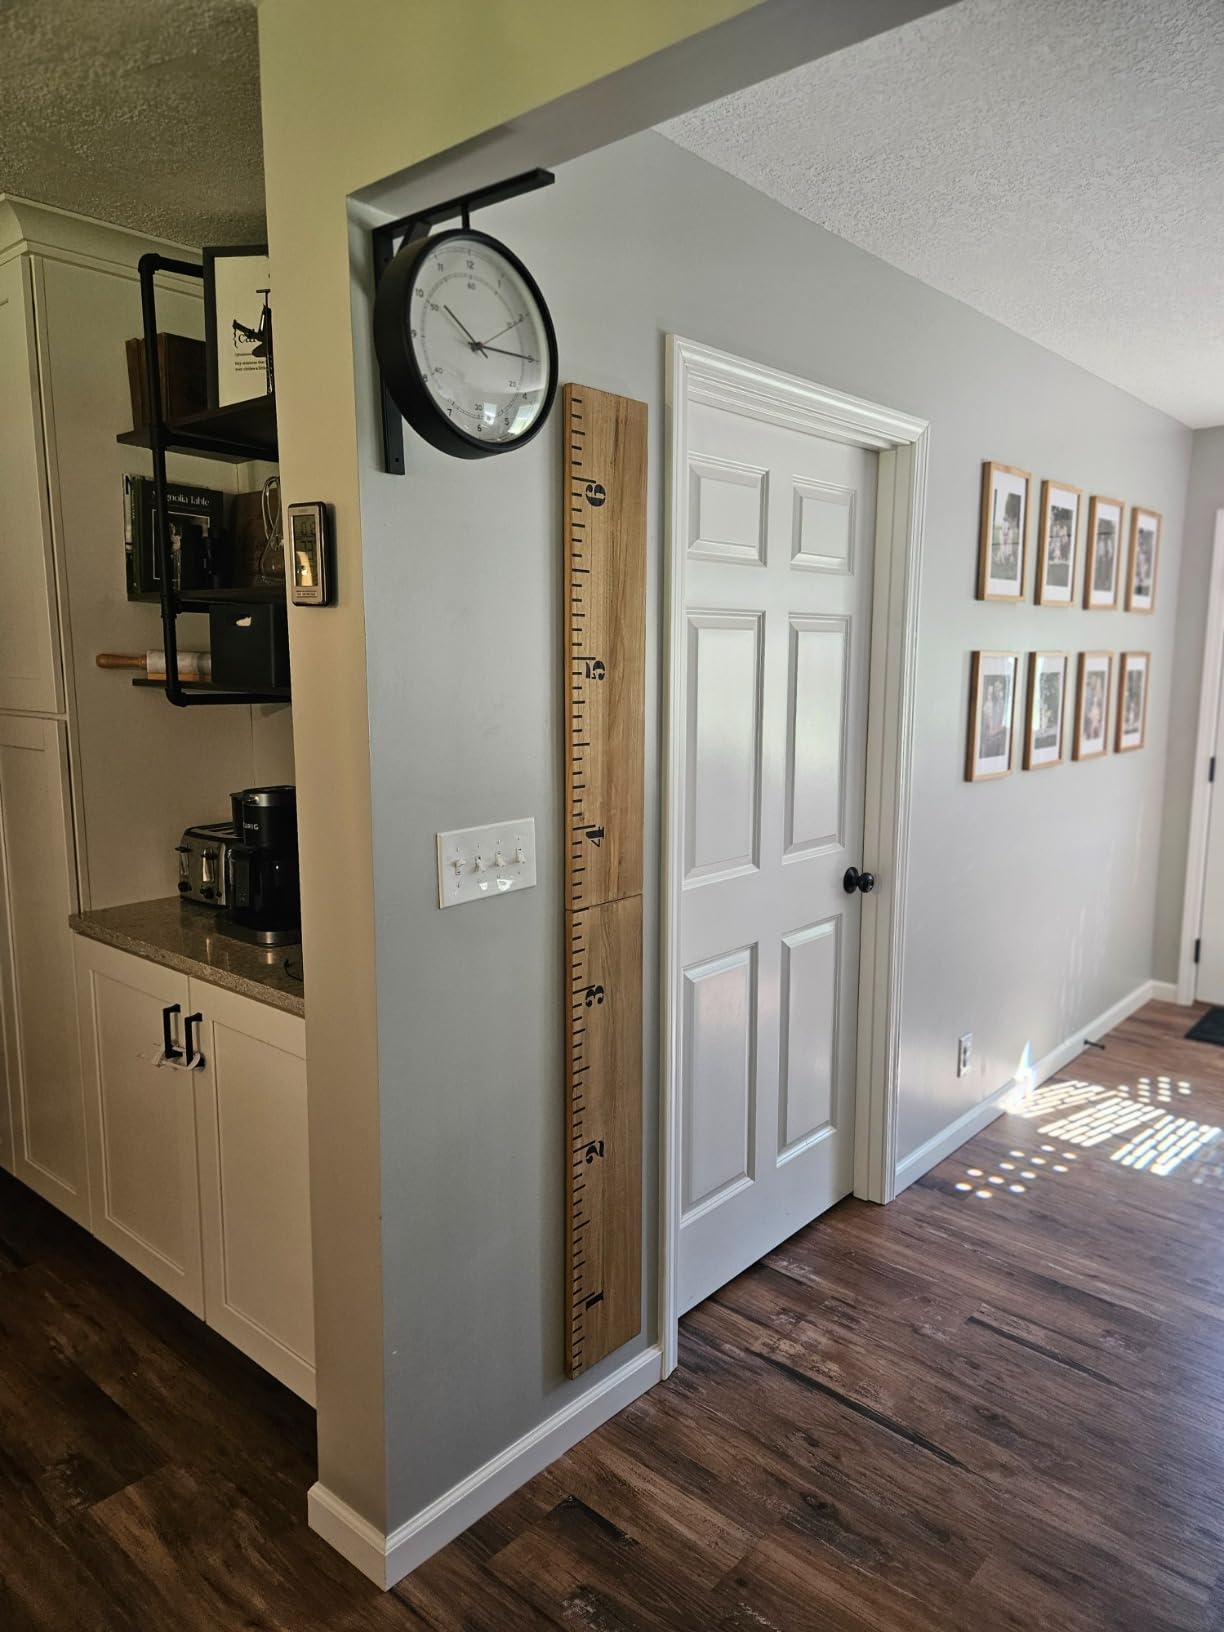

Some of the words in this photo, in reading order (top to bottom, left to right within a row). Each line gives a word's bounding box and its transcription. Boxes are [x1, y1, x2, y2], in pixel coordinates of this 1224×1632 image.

[437, 262, 444, 272] 11
[466, 260, 474, 270] 12
[466, 282, 476, 291] 60
[415, 288, 424, 298] 10
[430, 303, 439, 312] 50
[434, 366, 444, 375] 40
[522, 391, 528, 401] 4
[446, 407, 453, 417] 7
[474, 402, 484, 412] 30
[504, 417, 510, 427] 5
[477, 423, 483, 433] 6
[586, 483, 606, 507] 6
[586, 660, 606, 681] 5
[586, 826, 605, 848] 4
[585, 985, 605, 1008] 3
[586, 1140, 604, 1164] 2
[586, 1290, 604, 1310] 1
